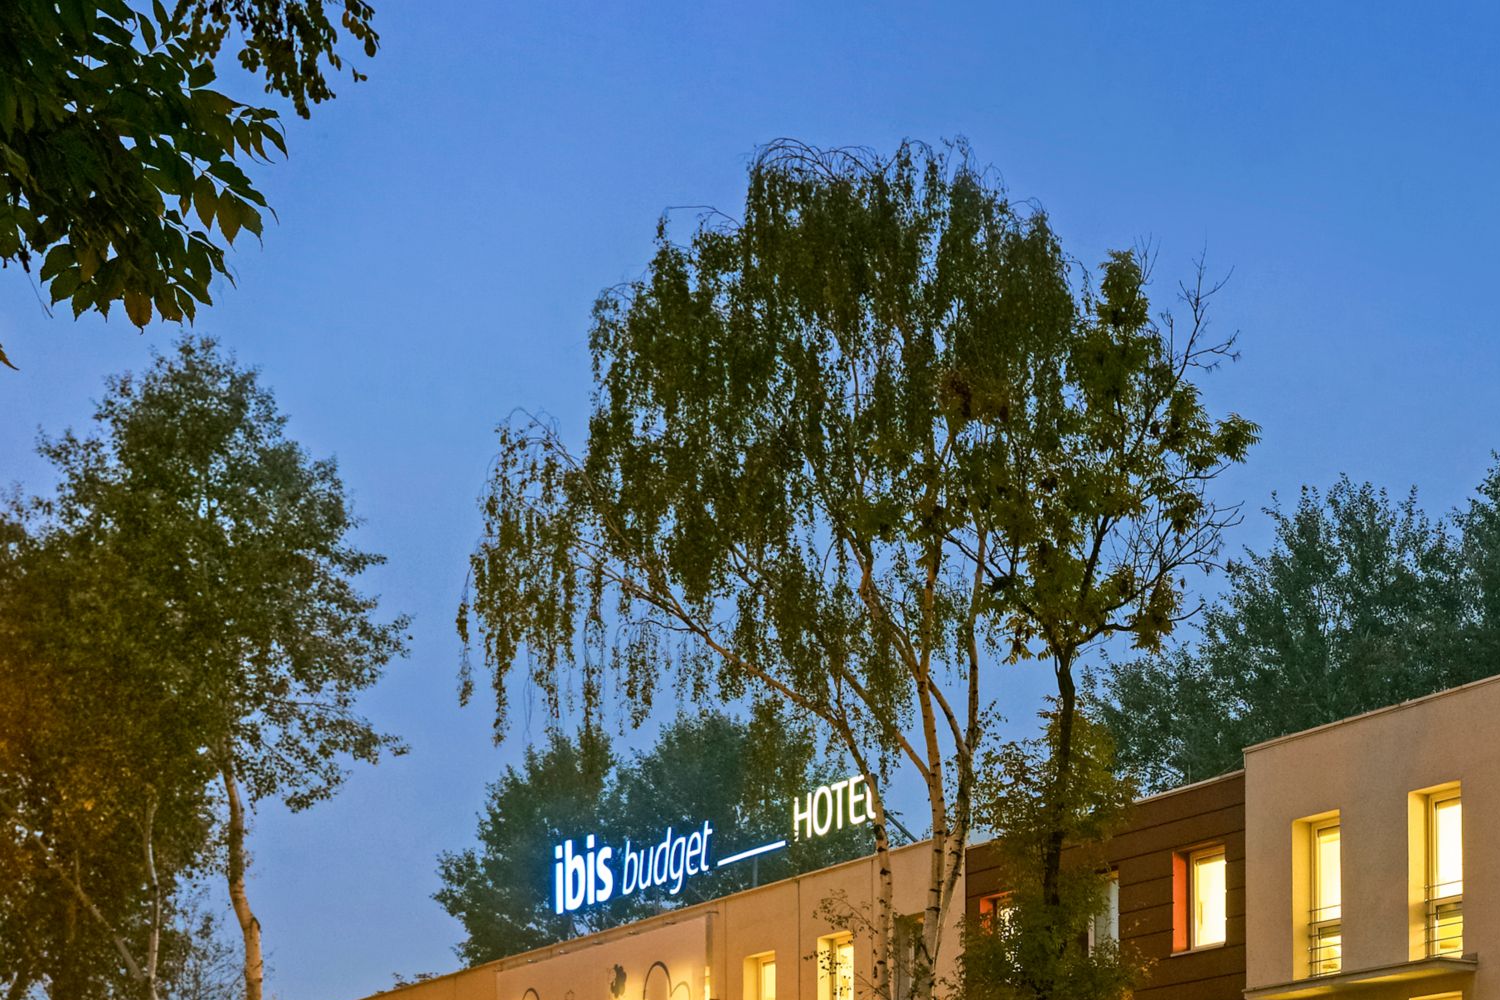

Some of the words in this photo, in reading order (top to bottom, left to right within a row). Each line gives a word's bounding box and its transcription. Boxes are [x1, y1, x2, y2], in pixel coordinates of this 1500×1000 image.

[555, 834, 614, 914] ibis
[622, 821, 712, 895] budget
[793, 774, 877, 842] HOTEL
